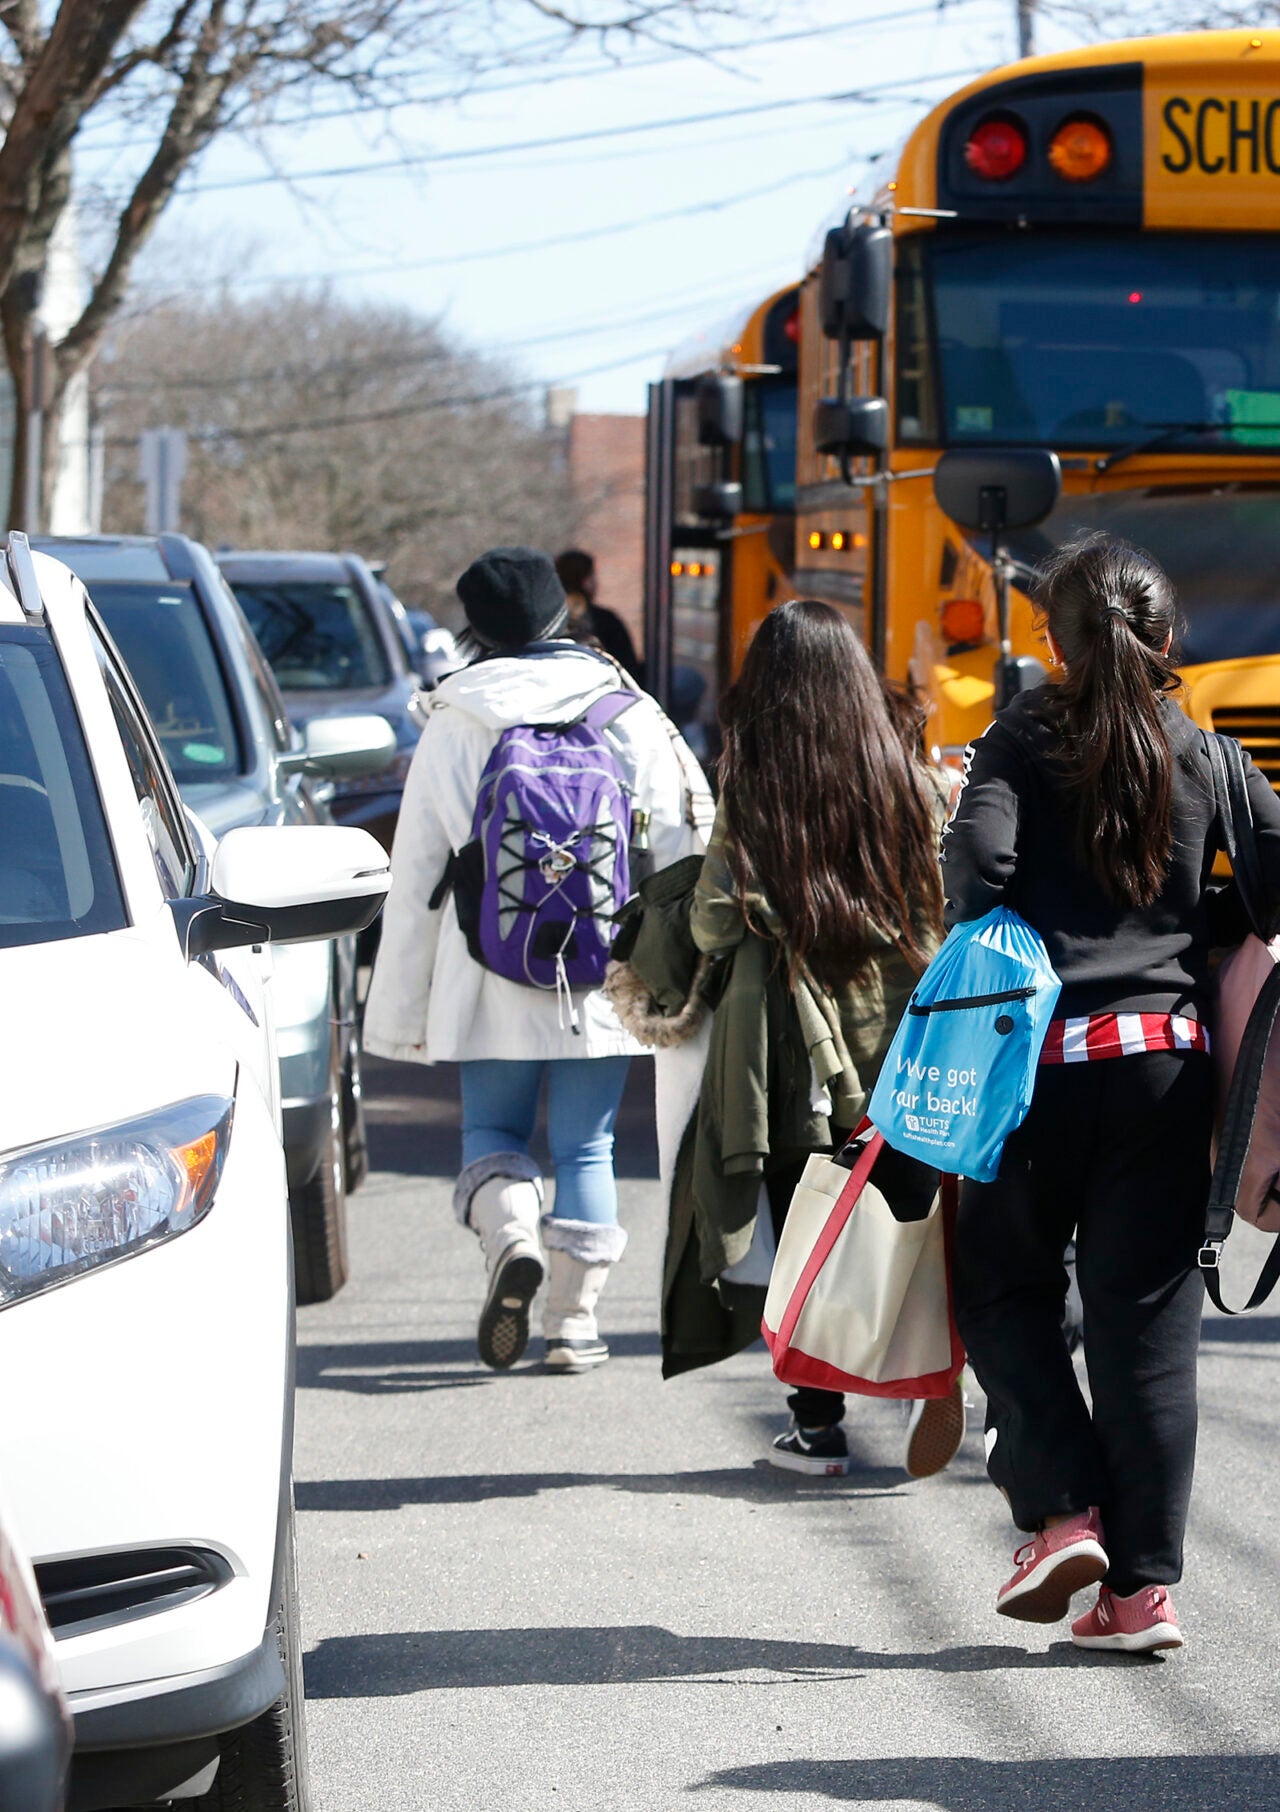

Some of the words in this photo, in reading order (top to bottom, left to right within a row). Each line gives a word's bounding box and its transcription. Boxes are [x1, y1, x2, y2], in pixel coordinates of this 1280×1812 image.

[947, 1067, 976, 1088] got
[927, 1091, 976, 1117] back!
[919, 1116, 950, 1130] TUFTS
[1097, 1603, 1110, 1627] N
